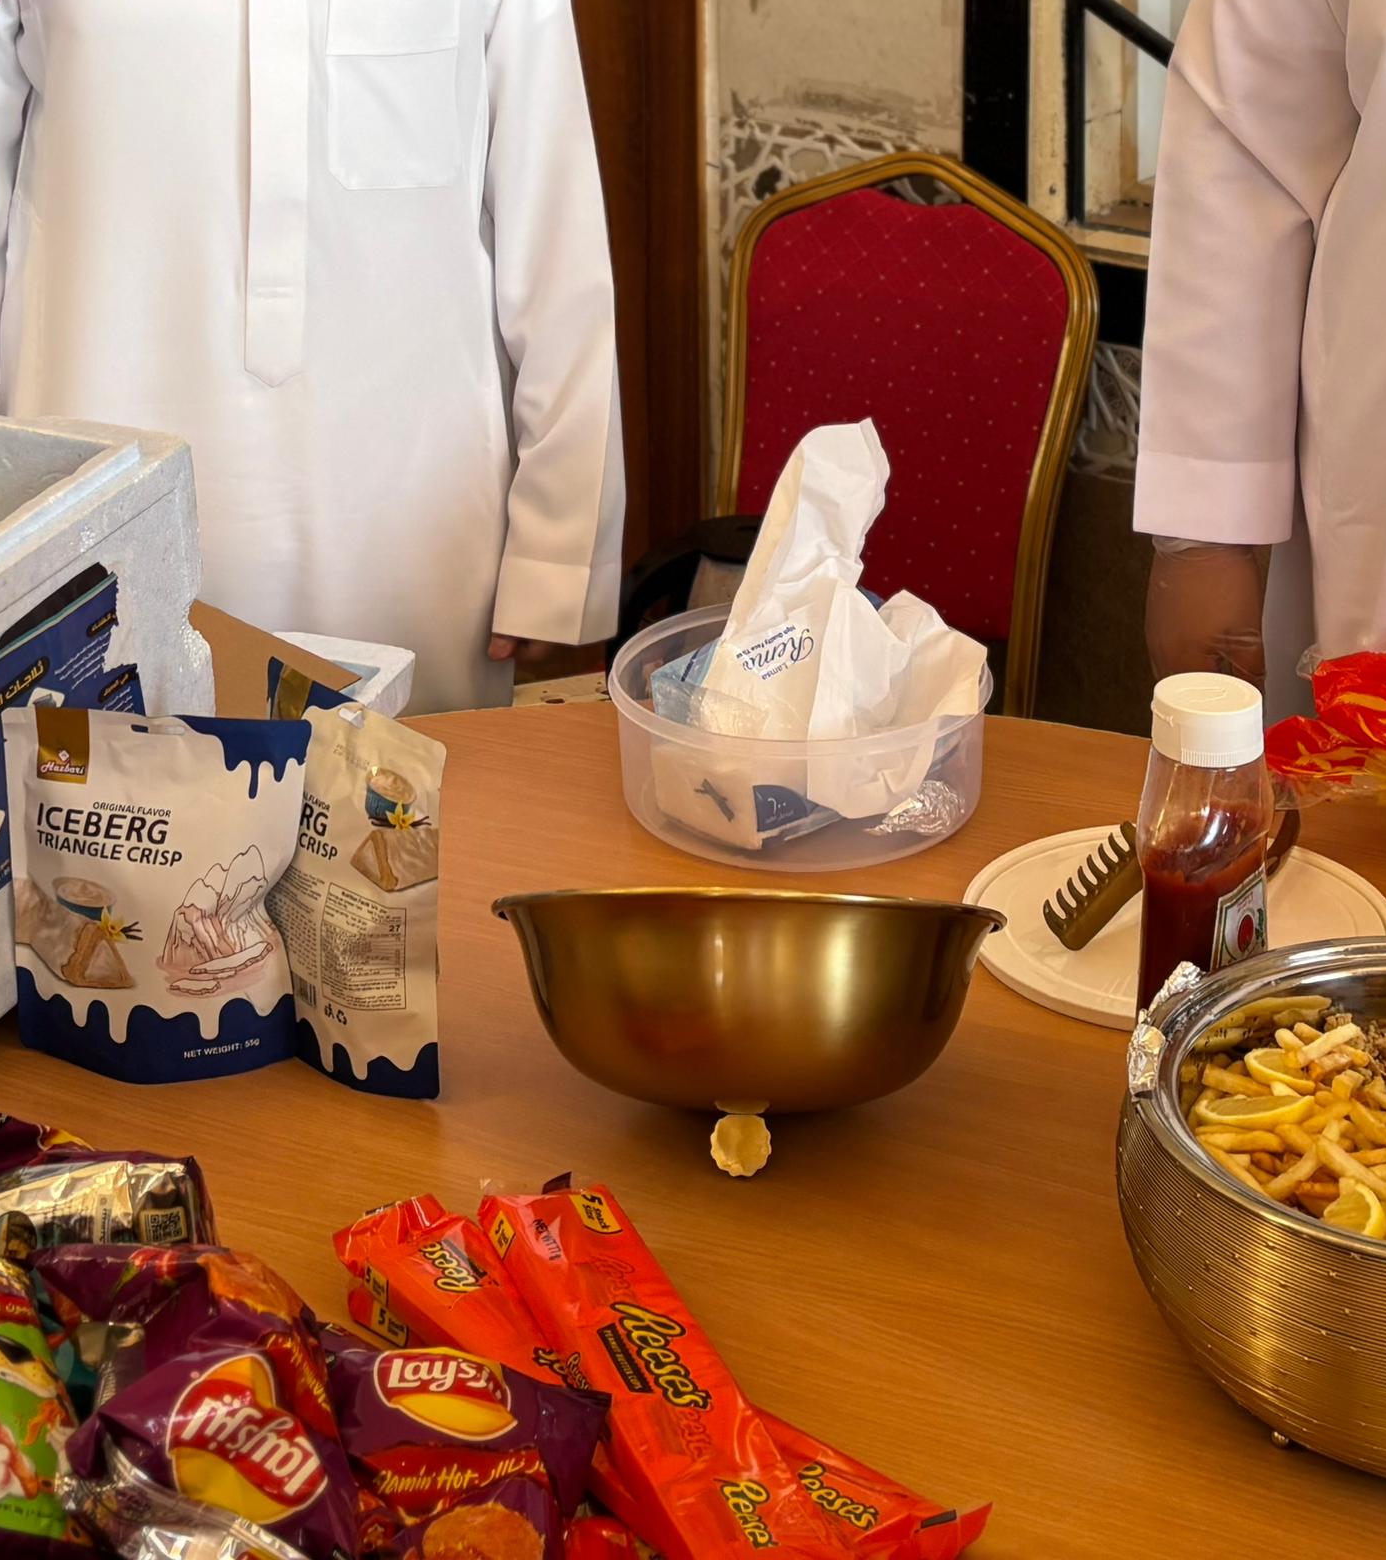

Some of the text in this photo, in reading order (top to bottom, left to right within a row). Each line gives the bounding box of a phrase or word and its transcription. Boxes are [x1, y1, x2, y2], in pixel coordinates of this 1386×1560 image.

[6, 659, 45, 700] ثلاجات
[37, 803, 169, 845] ICEBERG
[92, 801, 172, 818] ORIGINAL FLAVOR
[37, 829, 183, 867] TRIANGLE CRISP
[299, 832, 338, 861] CRISP
[388, 924, 401, 933] 27
[183, 1049, 202, 1059] NET
[582, 1193, 601, 1206] 5
[611, 1302, 712, 1409] Reese's
[388, 1358, 477, 1393] Lay's
[237, 1415, 324, 1496] Lay's
